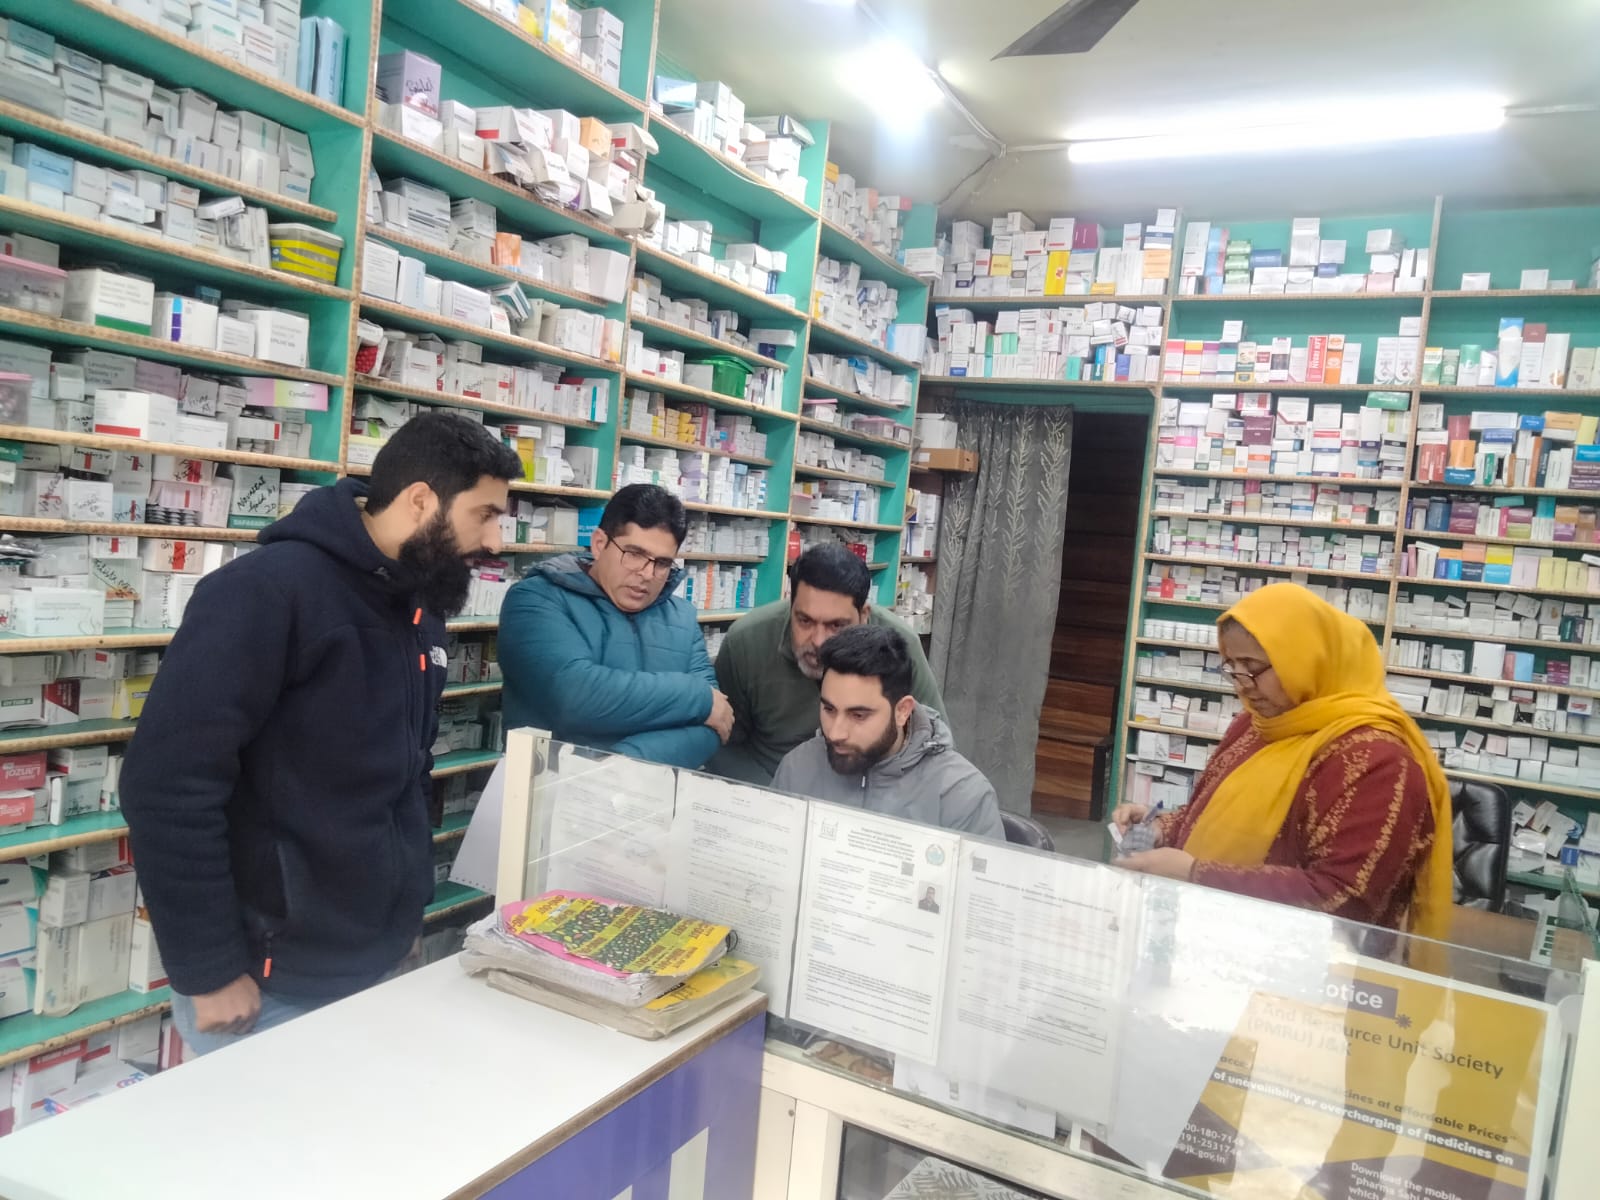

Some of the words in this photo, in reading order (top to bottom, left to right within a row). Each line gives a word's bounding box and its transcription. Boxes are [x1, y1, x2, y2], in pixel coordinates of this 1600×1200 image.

[1321, 981, 1385, 1009] otice
[1388, 1034, 1428, 1056] Unit
[1433, 1047, 1504, 1079] Society
[1213, 1070, 1226, 1081] of
[1320, 1101, 1404, 1134] overcharging
[1407, 1126, 1422, 1139] of
[1424, 1132, 1493, 1160] medicines
[1495, 1151, 1515, 1167] on
[1351, 1162, 1401, 1185] Download
[1404, 1179, 1423, 1193] the
